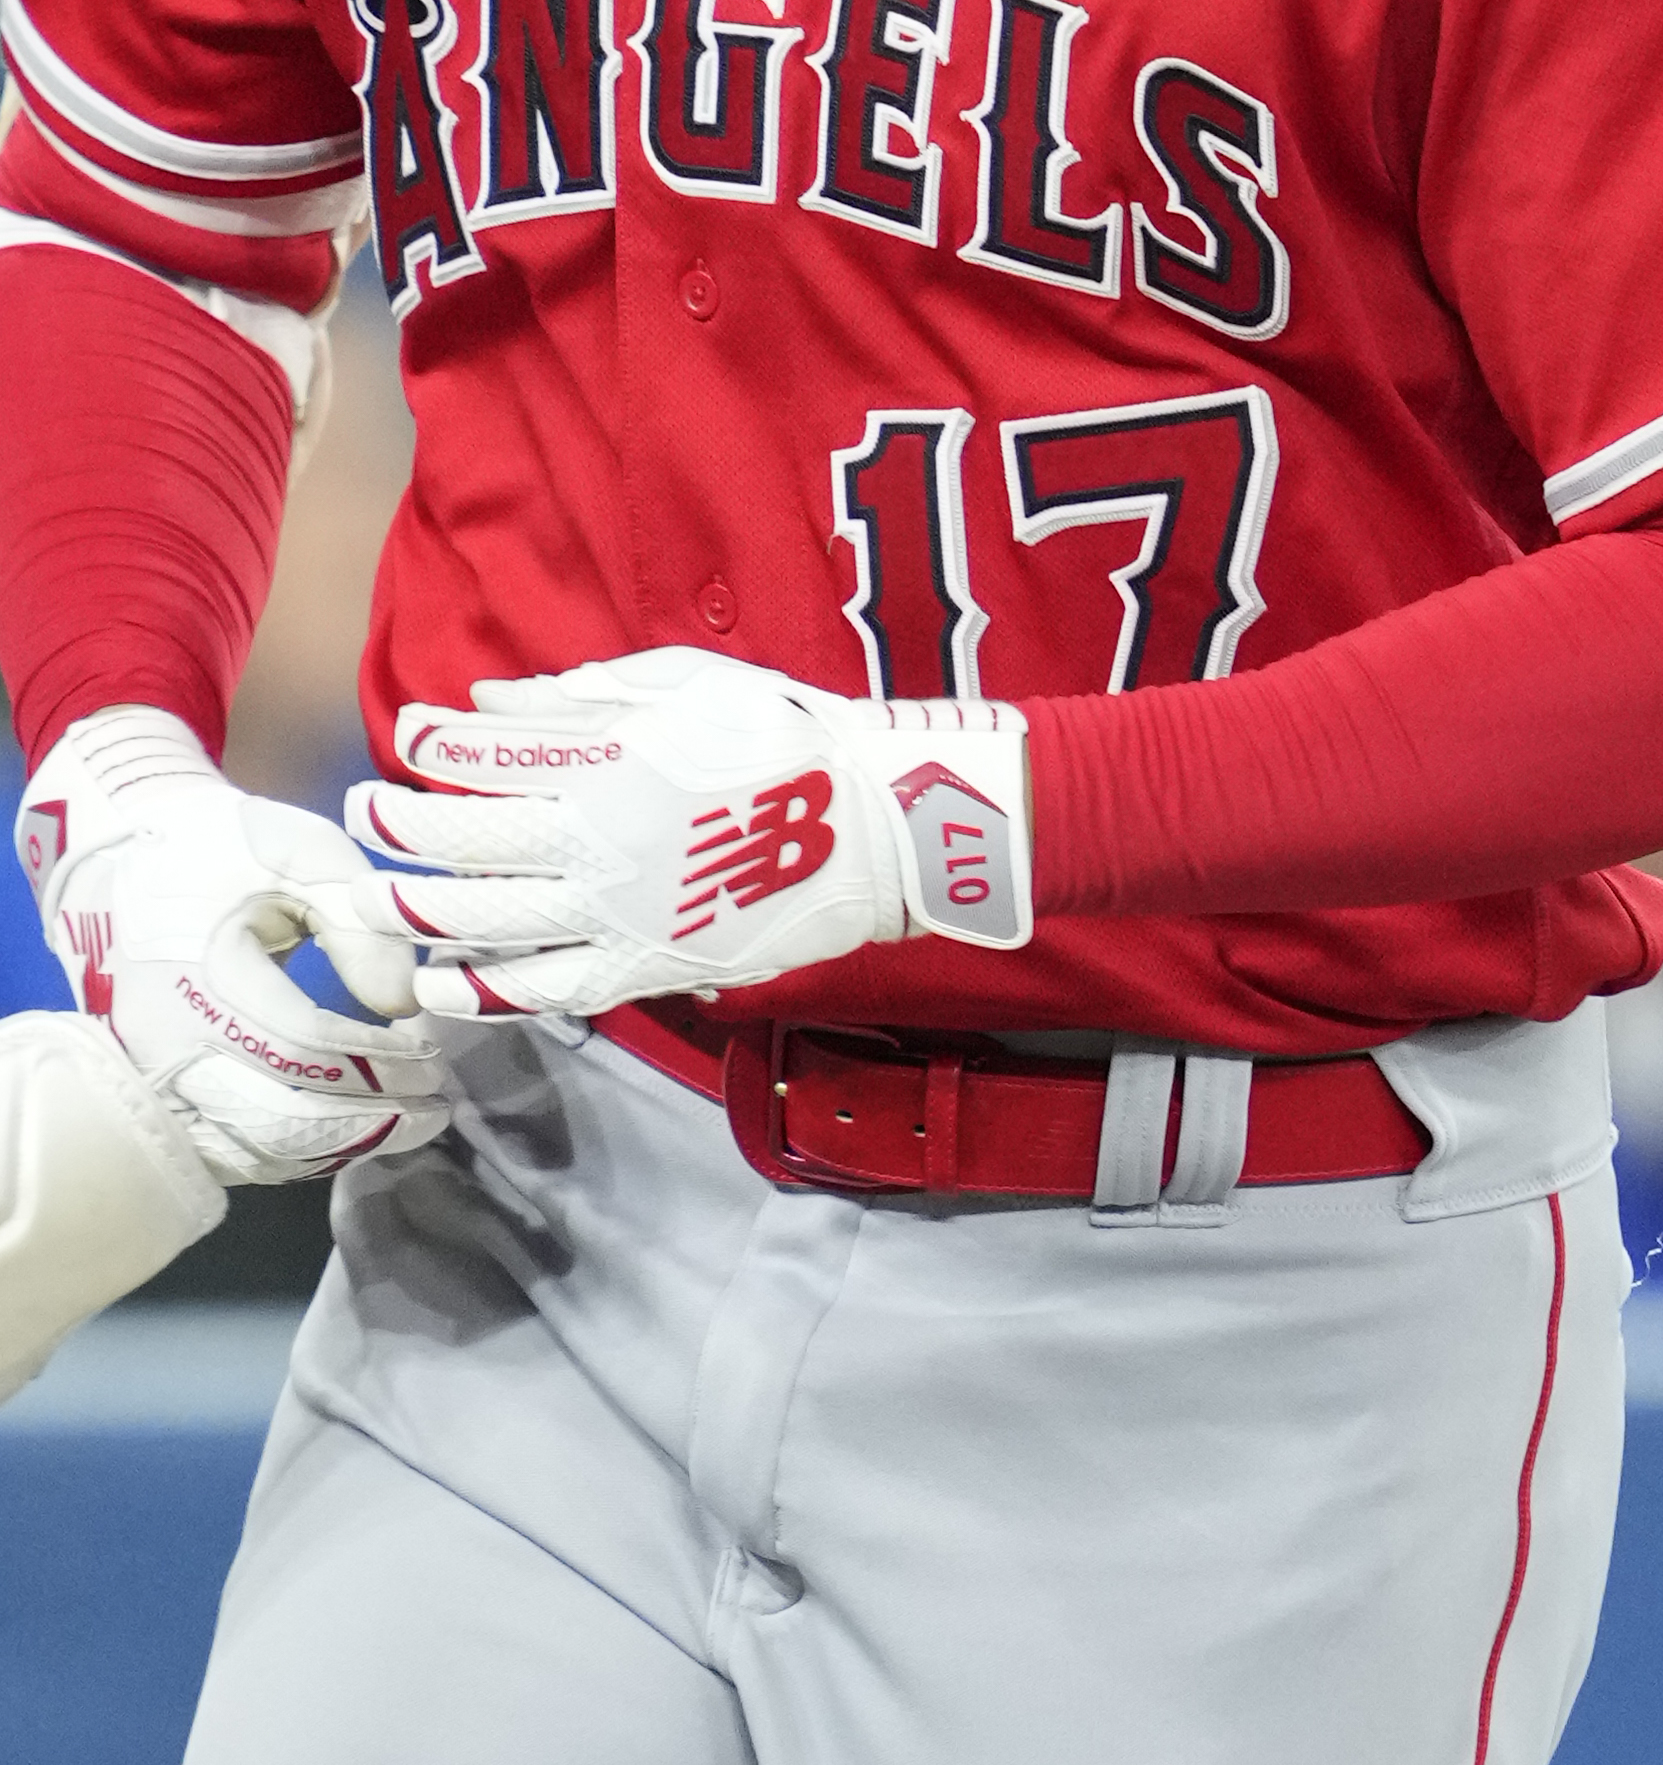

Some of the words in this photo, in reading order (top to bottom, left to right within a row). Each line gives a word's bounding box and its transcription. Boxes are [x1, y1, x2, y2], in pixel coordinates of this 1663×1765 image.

[832, 386, 1280, 700] 17
[436, 740, 486, 764] new
[495, 741, 623, 767] balance
[941, 821, 991, 905] 017
[175, 975, 223, 1024] new
[223, 1016, 344, 1082] balance
